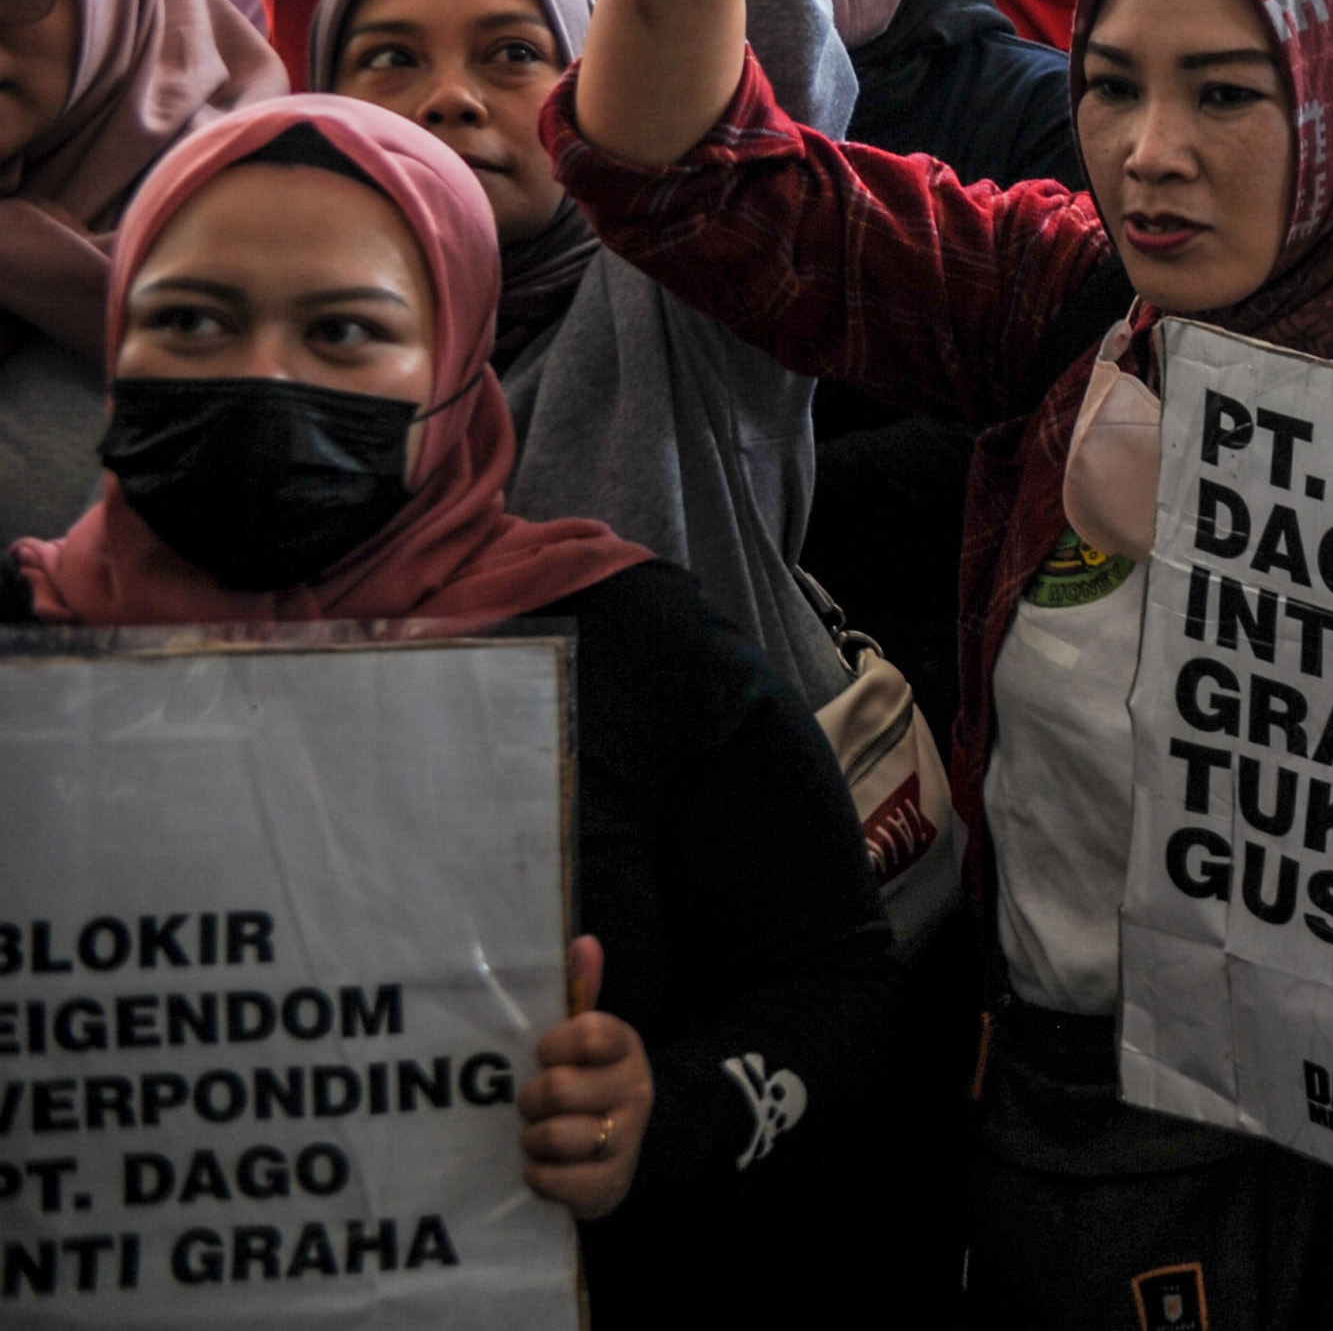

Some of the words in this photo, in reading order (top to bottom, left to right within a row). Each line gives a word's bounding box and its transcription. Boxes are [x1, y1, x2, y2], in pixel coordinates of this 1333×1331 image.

[1201, 388, 1325, 501] PT.
[123, 1141, 351, 1208] DAGO
[0, 1232, 141, 1300] NTI
[171, 1213, 460, 1286] GRAHA
